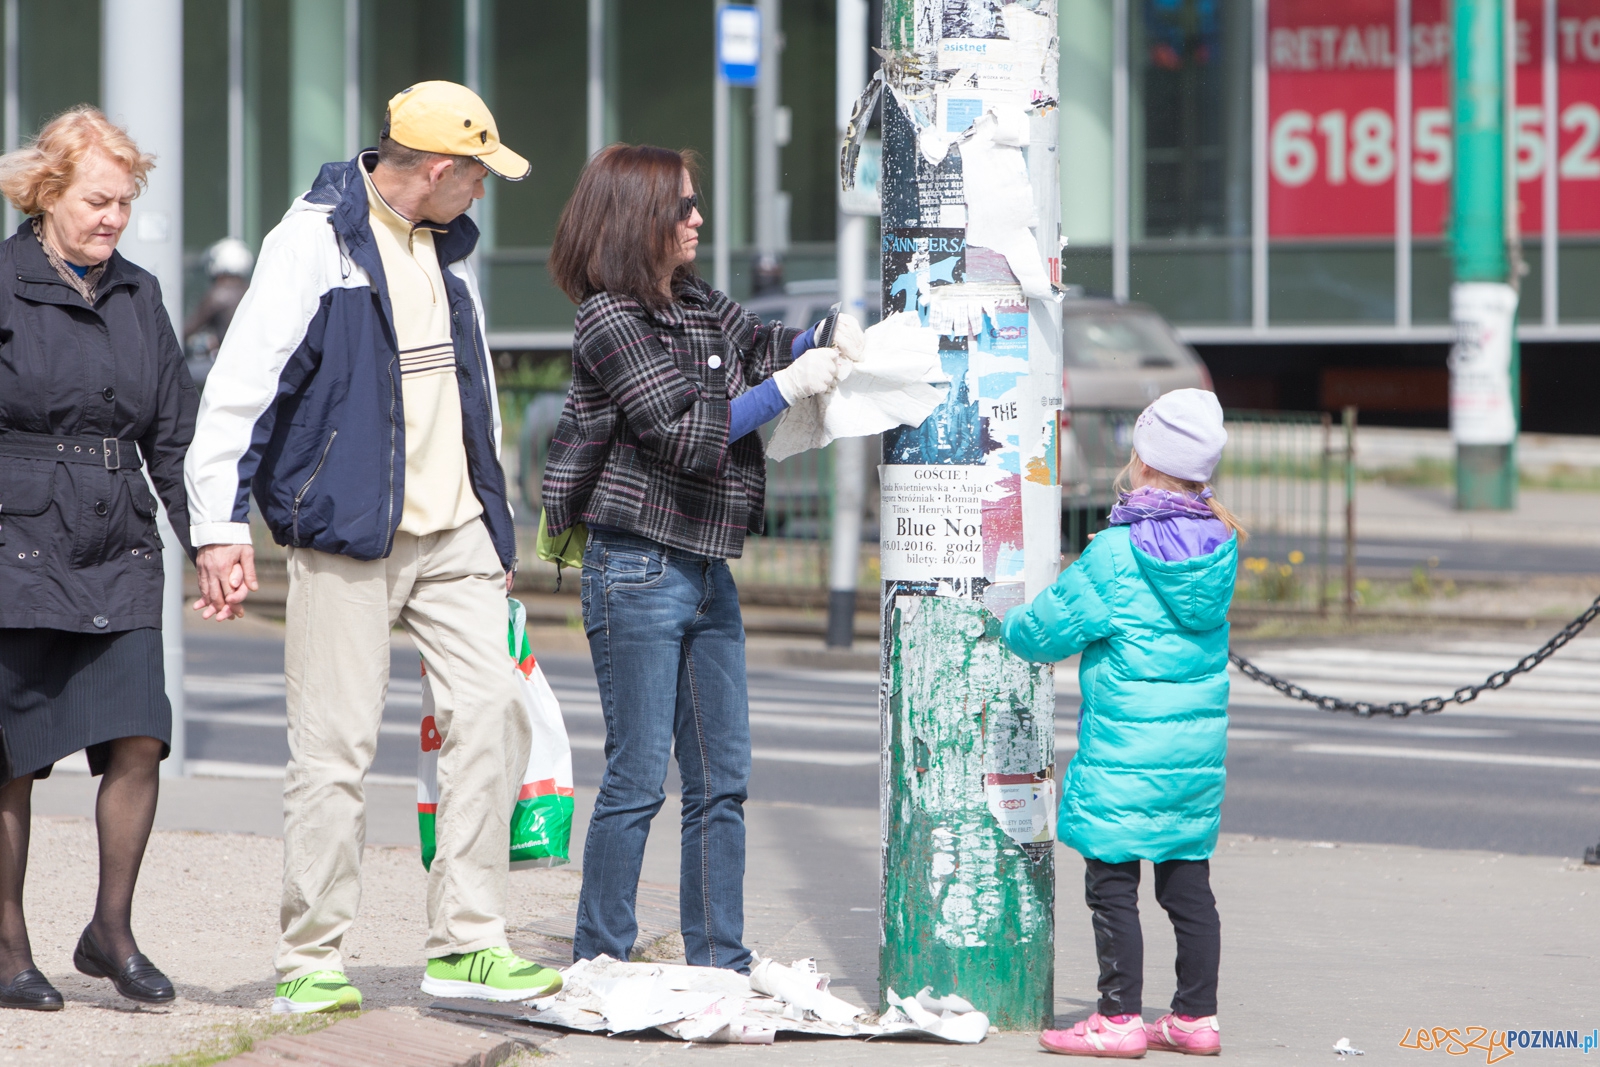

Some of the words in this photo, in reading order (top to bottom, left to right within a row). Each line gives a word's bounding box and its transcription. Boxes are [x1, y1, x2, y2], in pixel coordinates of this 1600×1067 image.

[943, 42, 987, 53] asistnet
[1271, 26, 1396, 71] RETAIL
[1411, 20, 1530, 67] SPE
[1271, 108, 1395, 187] 618
[992, 401, 1018, 421] THE
[914, 467, 961, 480] GOŚCIE
[894, 483, 949, 492] Kwietniewska
[960, 484, 982, 496] Anja
[897, 494, 935, 503] Stróżniak
[945, 494, 979, 503] Roman
[892, 504, 910, 513] Titus
[918, 505, 952, 517] Henryk
[896, 517, 936, 537] Blue
[946, 540, 981, 556] godz
[906, 553, 938, 567] bilety:
